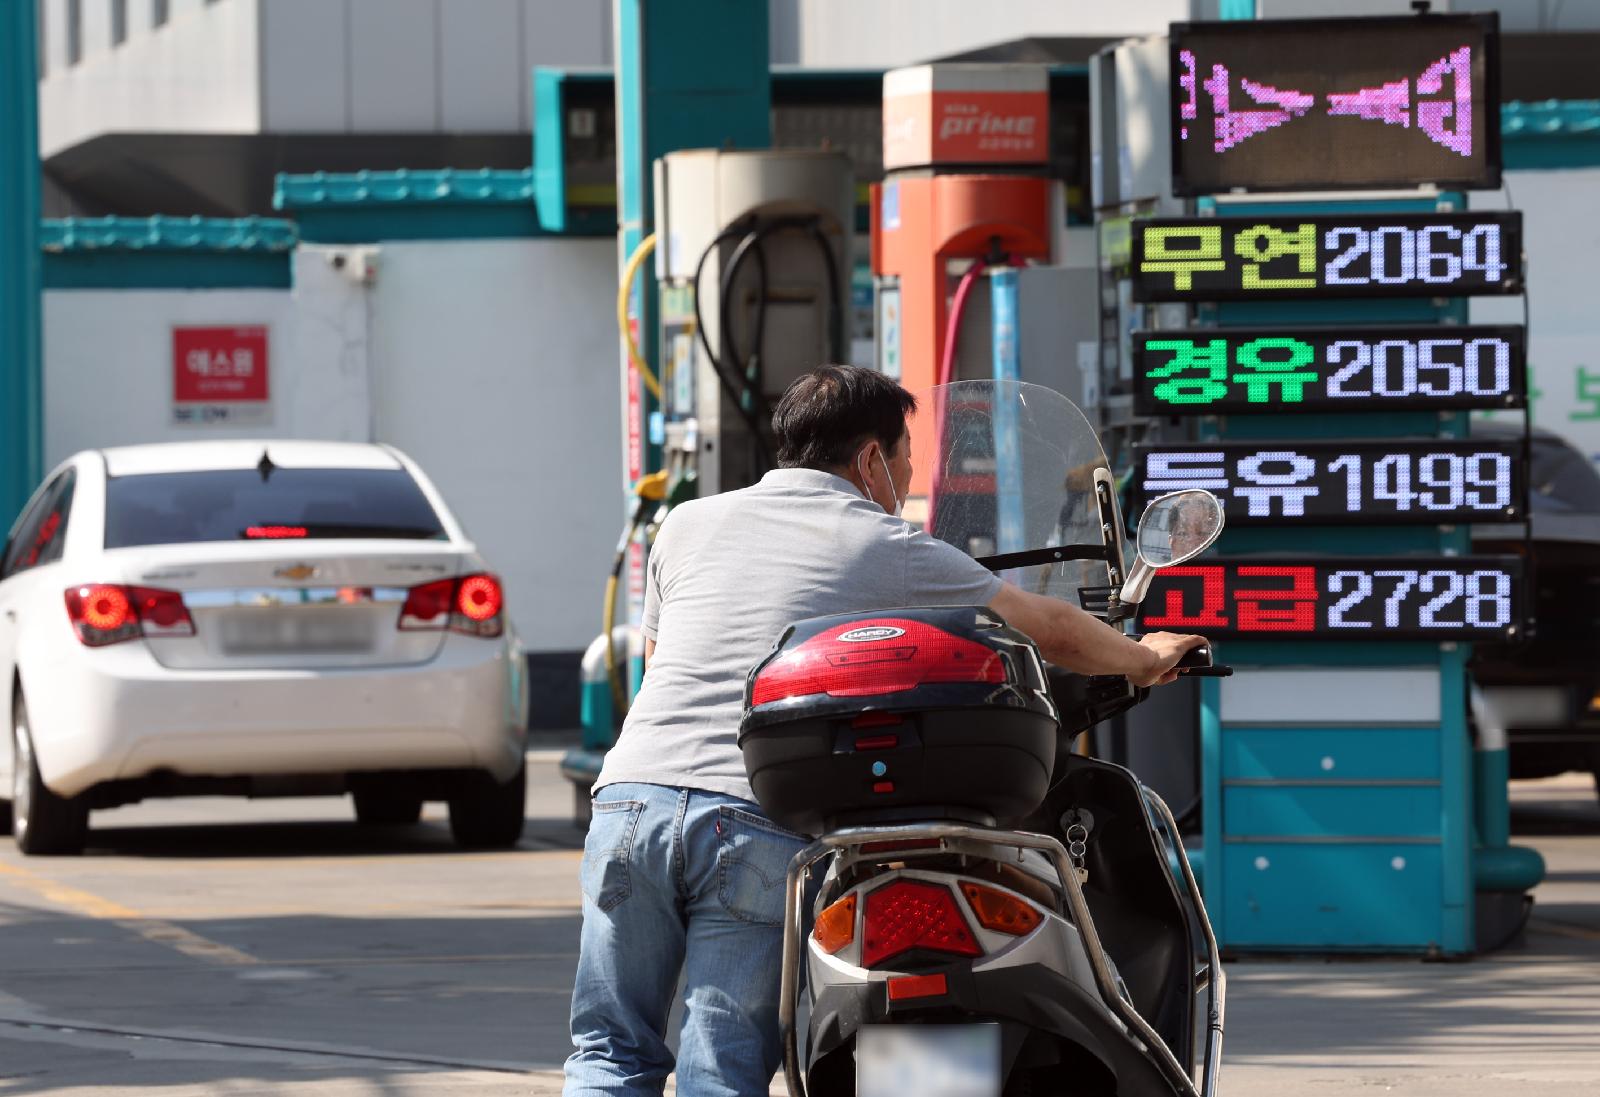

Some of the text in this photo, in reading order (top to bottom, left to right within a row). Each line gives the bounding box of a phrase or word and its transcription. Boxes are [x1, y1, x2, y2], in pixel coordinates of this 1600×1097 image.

[1141, 225, 1507, 290] 무연 2064
[1145, 338, 1318, 404] 경유
[1326, 338, 1510, 398] 2050
[1328, 452, 1511, 511] 1499
[1143, 566, 1511, 632] 고급 2728
